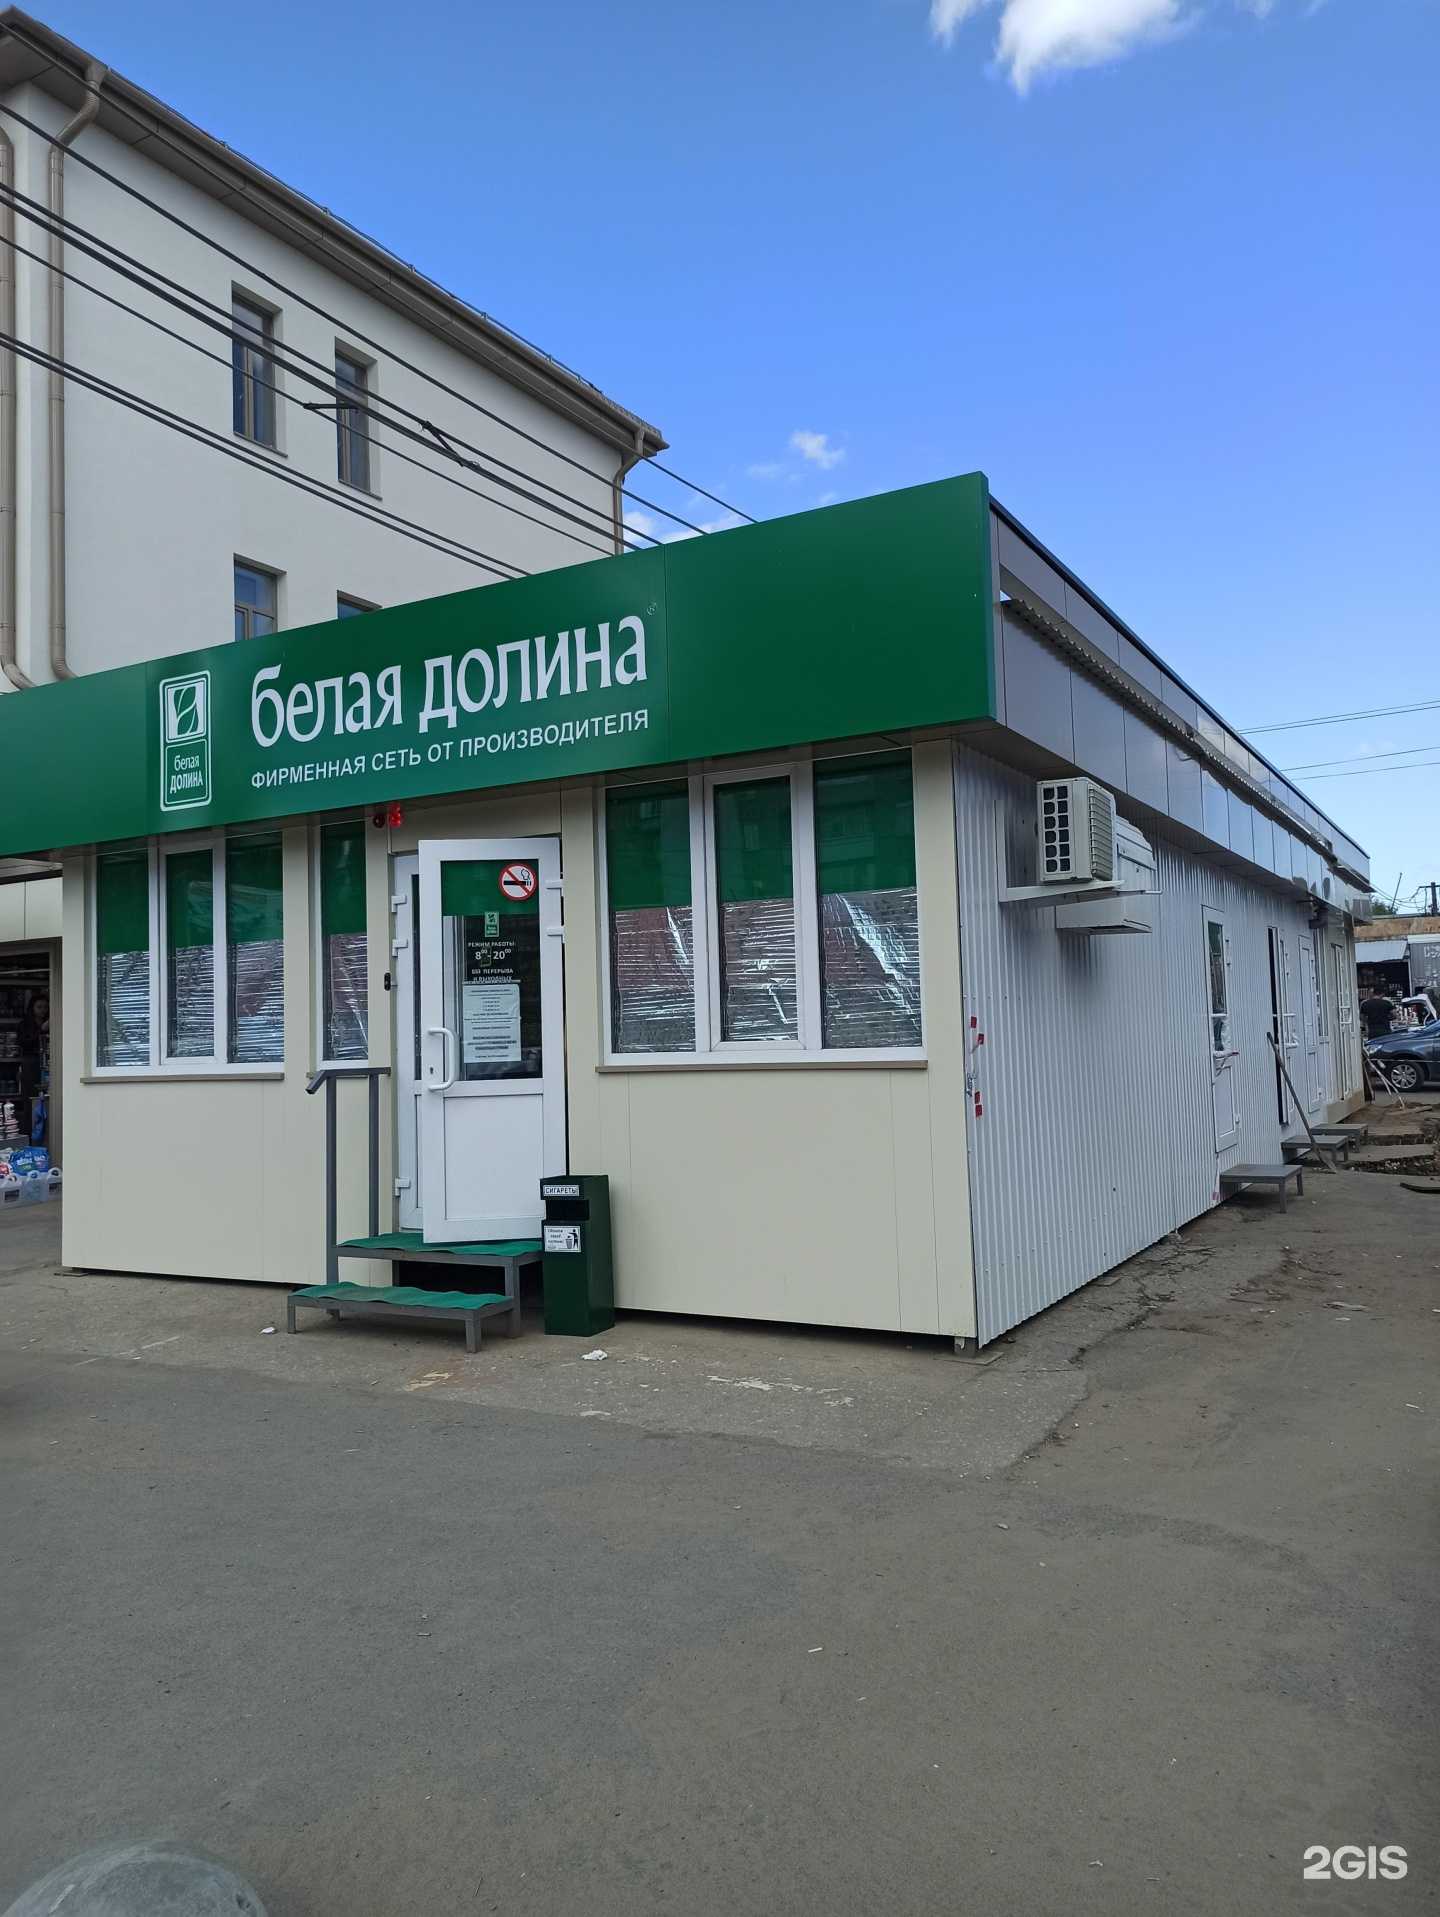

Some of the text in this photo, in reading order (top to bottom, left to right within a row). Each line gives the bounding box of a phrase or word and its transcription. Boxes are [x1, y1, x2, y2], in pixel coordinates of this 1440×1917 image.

[251, 615, 648, 748] белая долина
[174, 755, 200, 771] белая
[251, 709, 649, 789] ФИРМЕННАЯ СЕТЬ ОТ ПРОИЗВОДИТЕЛЯ
